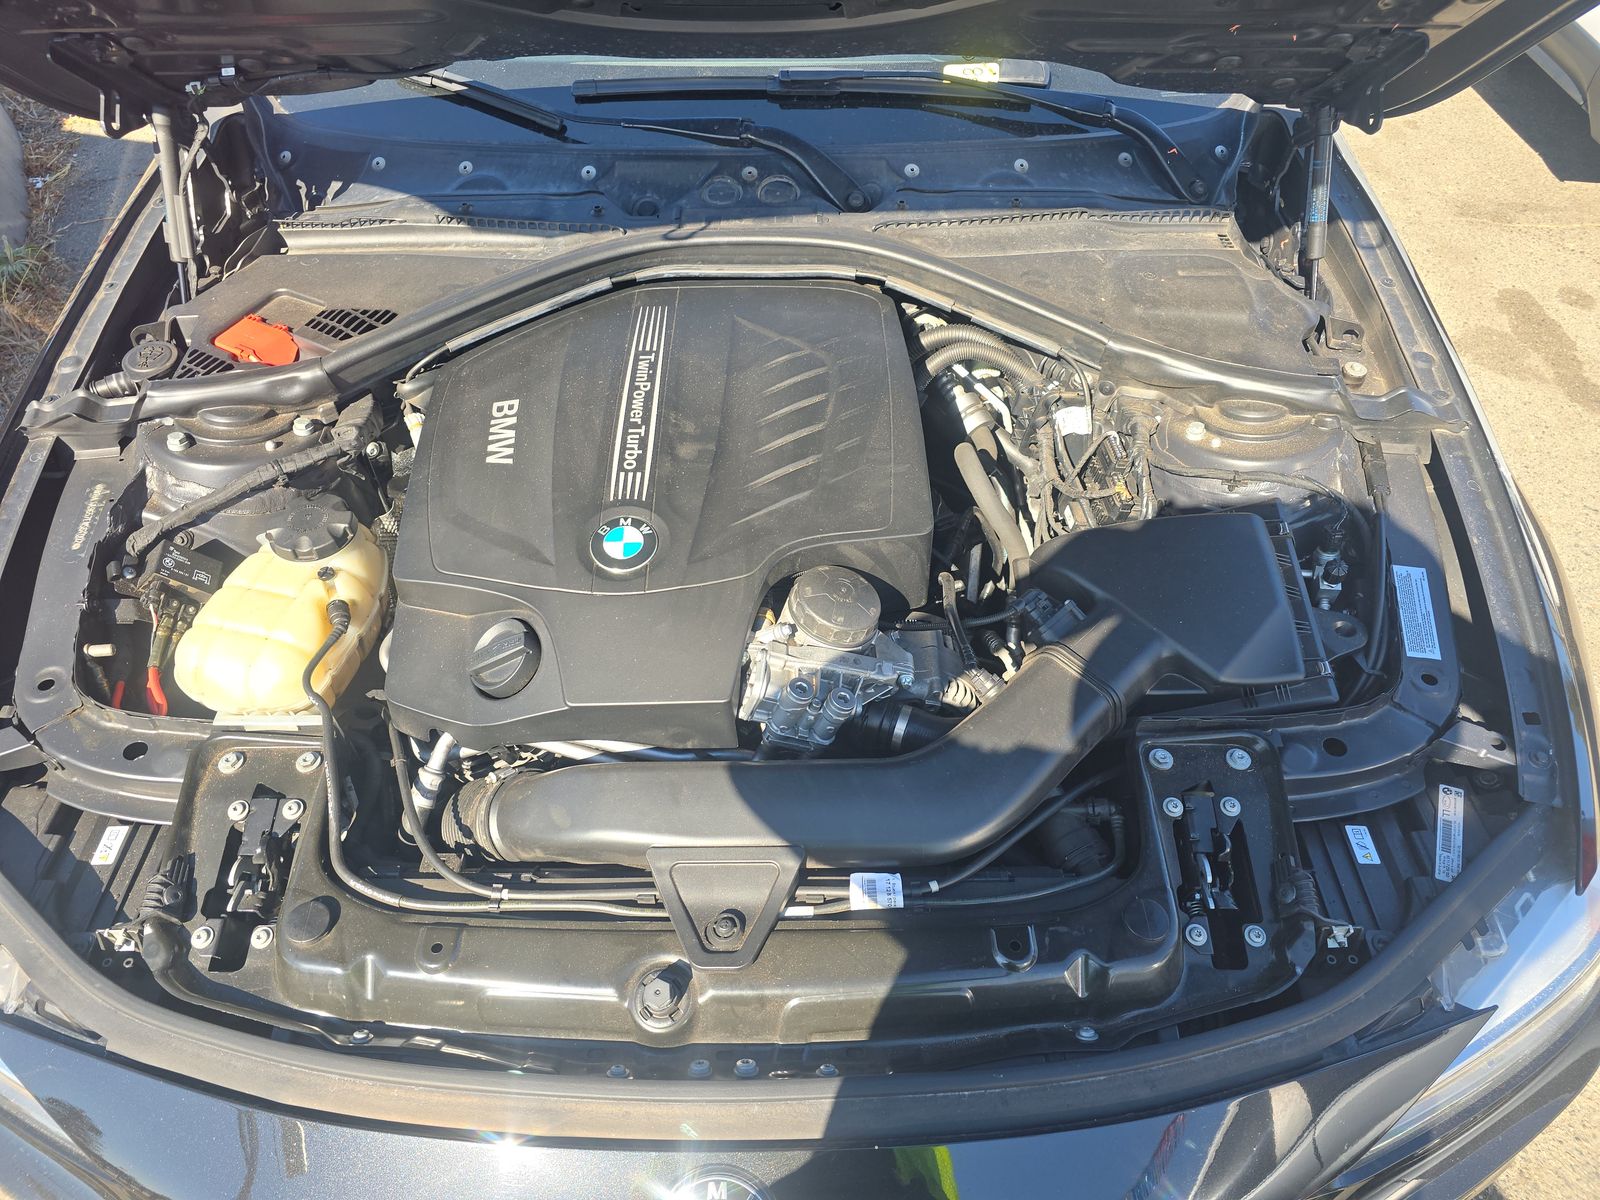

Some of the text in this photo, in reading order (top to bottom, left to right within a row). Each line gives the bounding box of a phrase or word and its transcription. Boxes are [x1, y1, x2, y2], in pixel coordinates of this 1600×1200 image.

[485, 398, 520, 465] BMW
[623, 352, 655, 470] TwinPower Turbo
[597, 517, 653, 536] BMW
